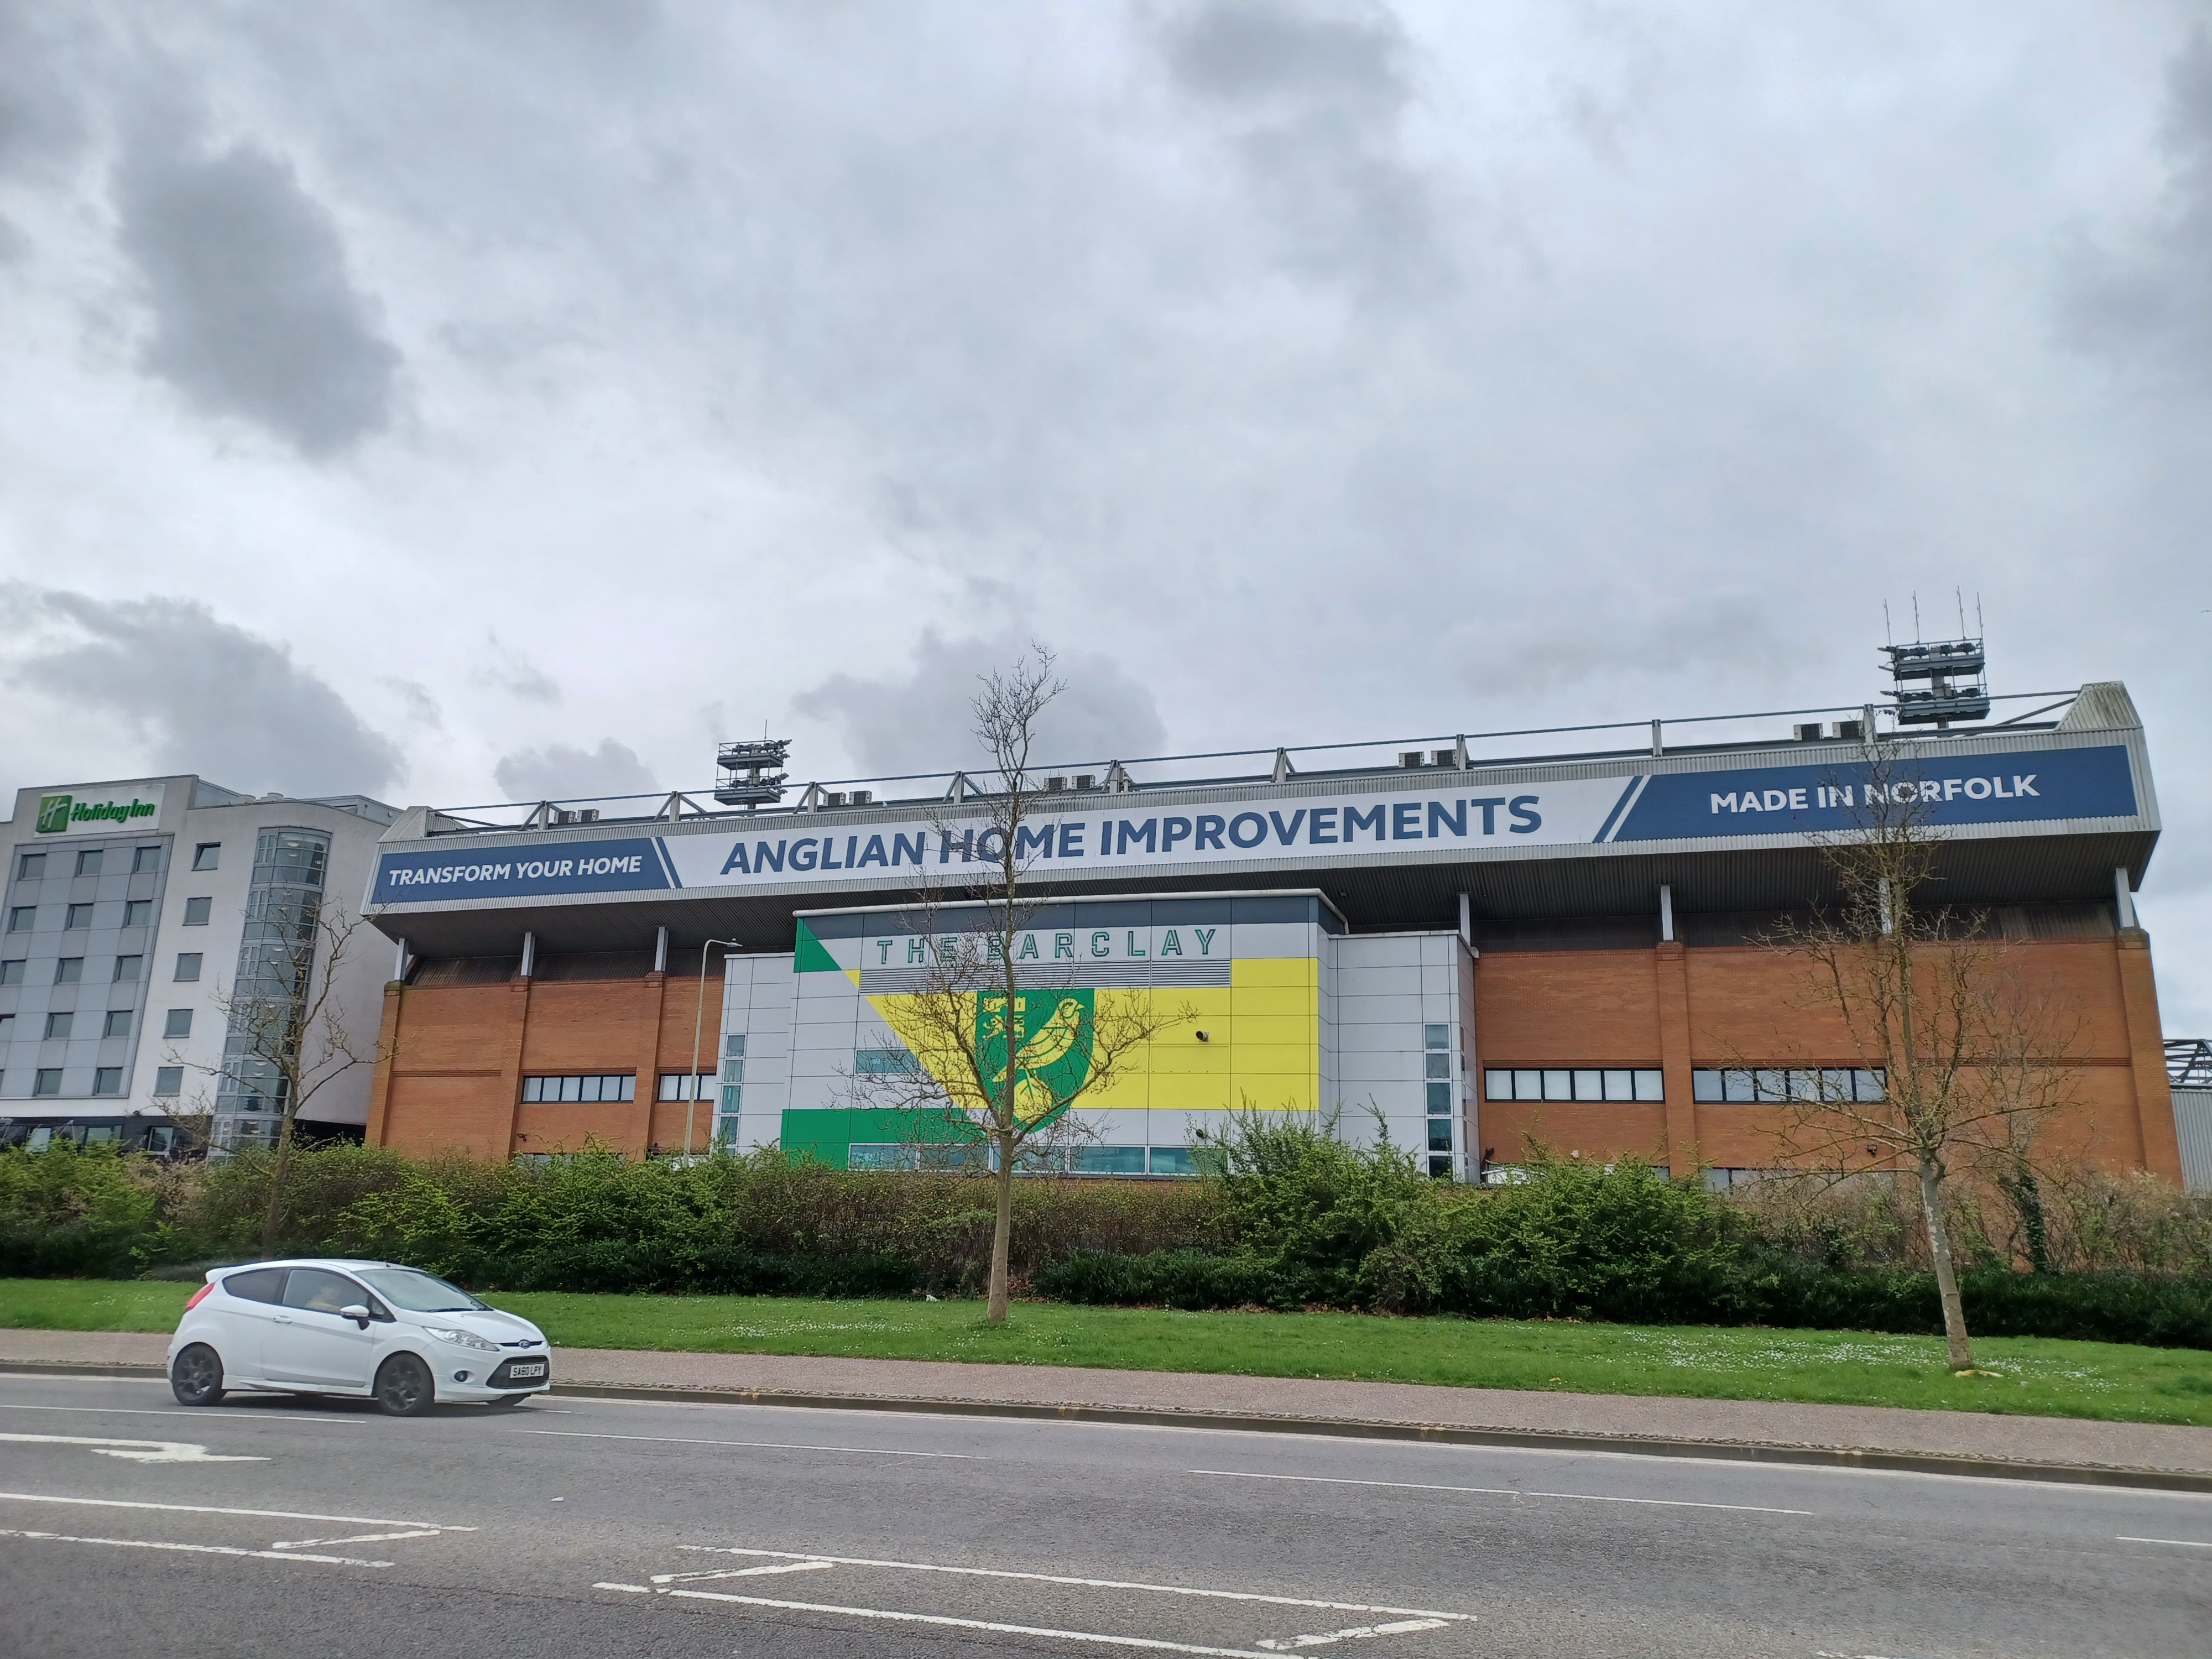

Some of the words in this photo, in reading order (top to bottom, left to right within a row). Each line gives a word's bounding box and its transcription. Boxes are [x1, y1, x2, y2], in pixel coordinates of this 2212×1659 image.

[70, 801, 130, 823] Holiday
[129, 799, 155, 818] Inn
[1711, 788, 1808, 813] MADE
[1817, 786, 1854, 808] IN
[1864, 775, 2041, 805] NORFOLK
[721, 832, 926, 875] ANGLIAN
[940, 822, 1086, 864] HOME
[1101, 795, 1542, 855] IMPROVEMENTS
[390, 863, 511, 885] TRANSFORM
[516, 860, 573, 879] YOUR
[578, 856, 643, 875] HOME
[877, 936, 958, 964] THE
[988, 928, 1216, 961] BARCLAY
